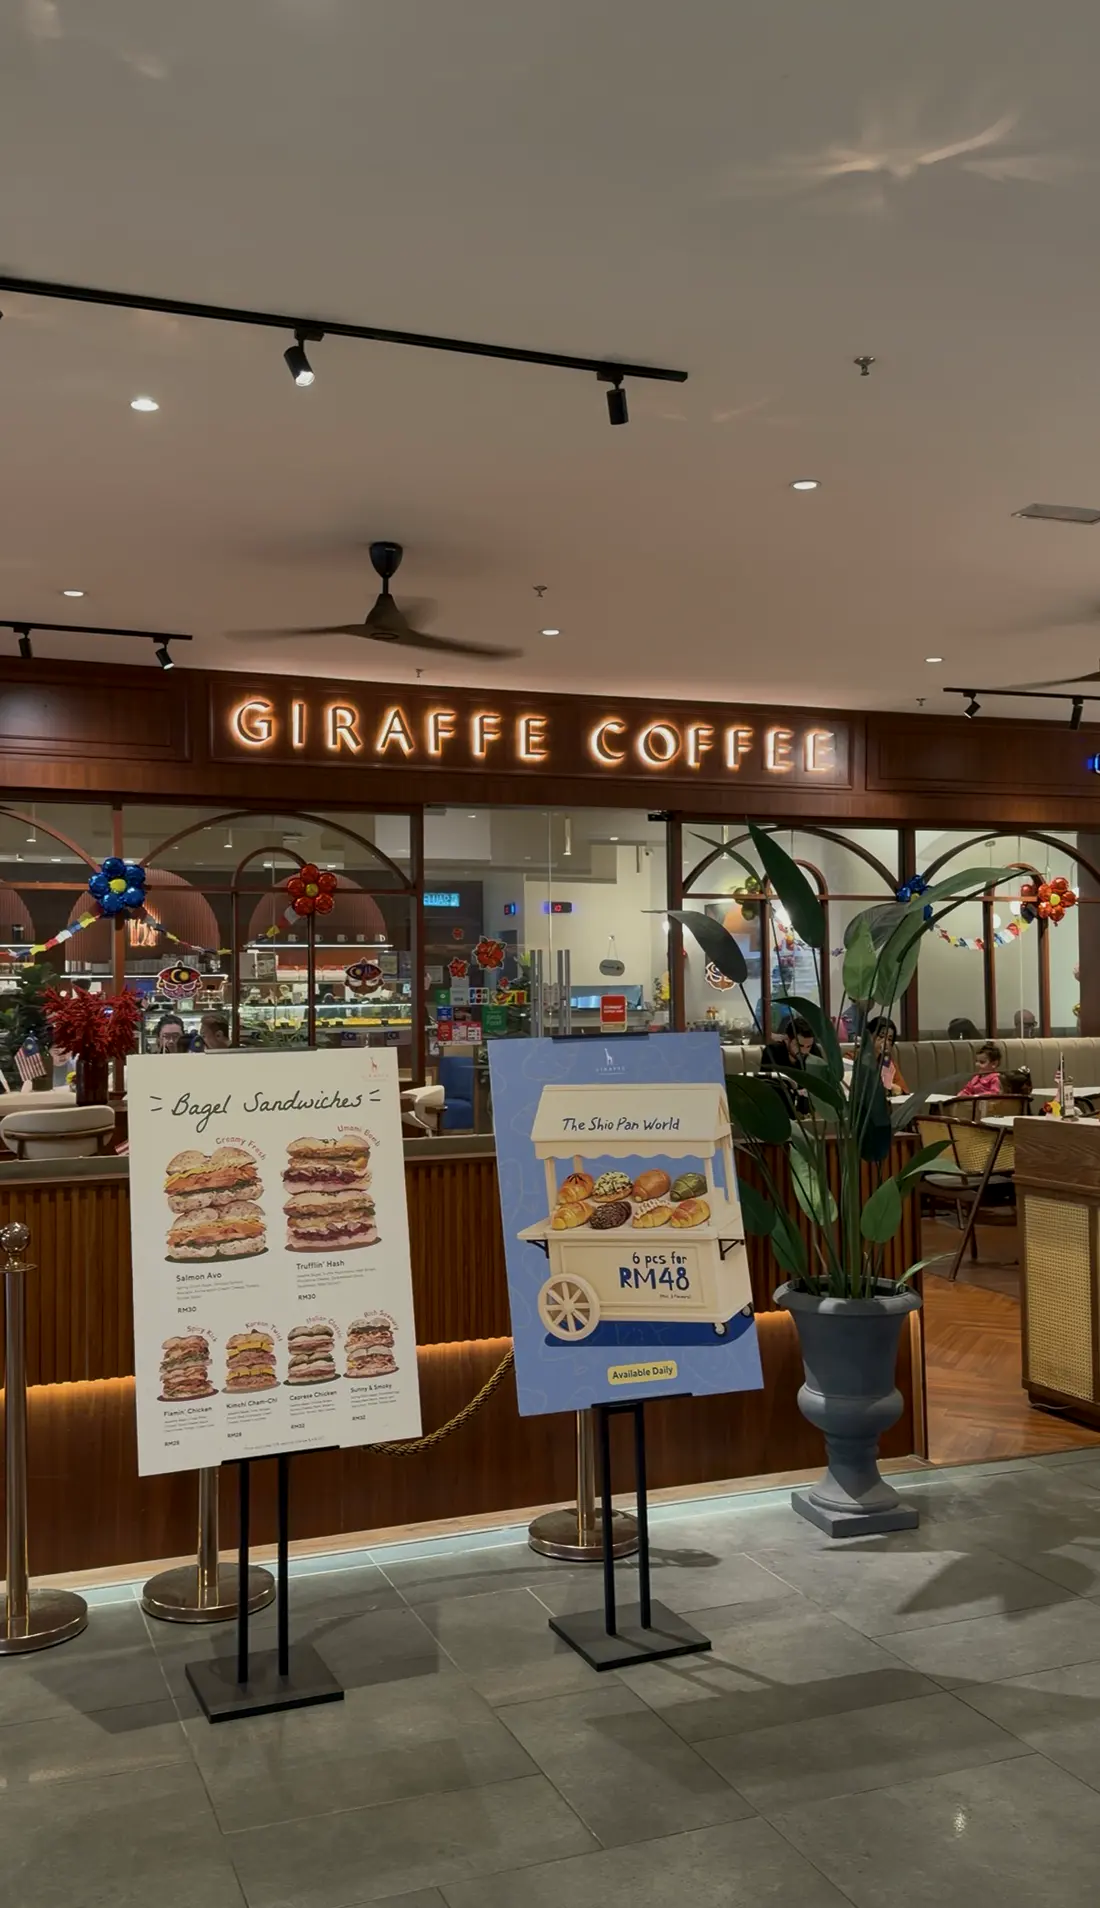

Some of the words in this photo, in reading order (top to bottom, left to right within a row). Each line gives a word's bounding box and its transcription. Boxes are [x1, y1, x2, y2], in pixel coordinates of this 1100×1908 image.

[233, 699, 549, 759] GIRAFFE
[590, 719, 836, 773] COFFEE
[171, 1091, 232, 1133] Bagel
[243, 1090, 363, 1113] Sandwiches
[562, 1117, 585, 1131] The
[588, 1116, 614, 1131] Shio
[616, 1116, 639, 1131] Pan
[643, 1117, 680, 1131] World
[215, 1137, 246, 1146] Creamy
[247, 1139, 267, 1161] Fresh
[326, 1260, 345, 1268] Hash
[632, 1252, 641, 1264] 6
[645, 1254, 667, 1268] pcs
[671, 1251, 688, 1264] for
[176, 1273, 205, 1282] Salmon
[619, 1266, 690, 1291] RM48
[612, 1365, 651, 1379] Available
[652, 1365, 674, 1376] Daily
[350, 1386, 368, 1394] Sunny
[374, 1383, 392, 1391] Smoky
[226, 1400, 247, 1409] Kimchi
[247, 1397, 278, 1407] Cham-Chi
[289, 1393, 313, 1402] Caprese
[314, 1390, 338, 1398] Chicken
[187, 1406, 213, 1415] Chicken
